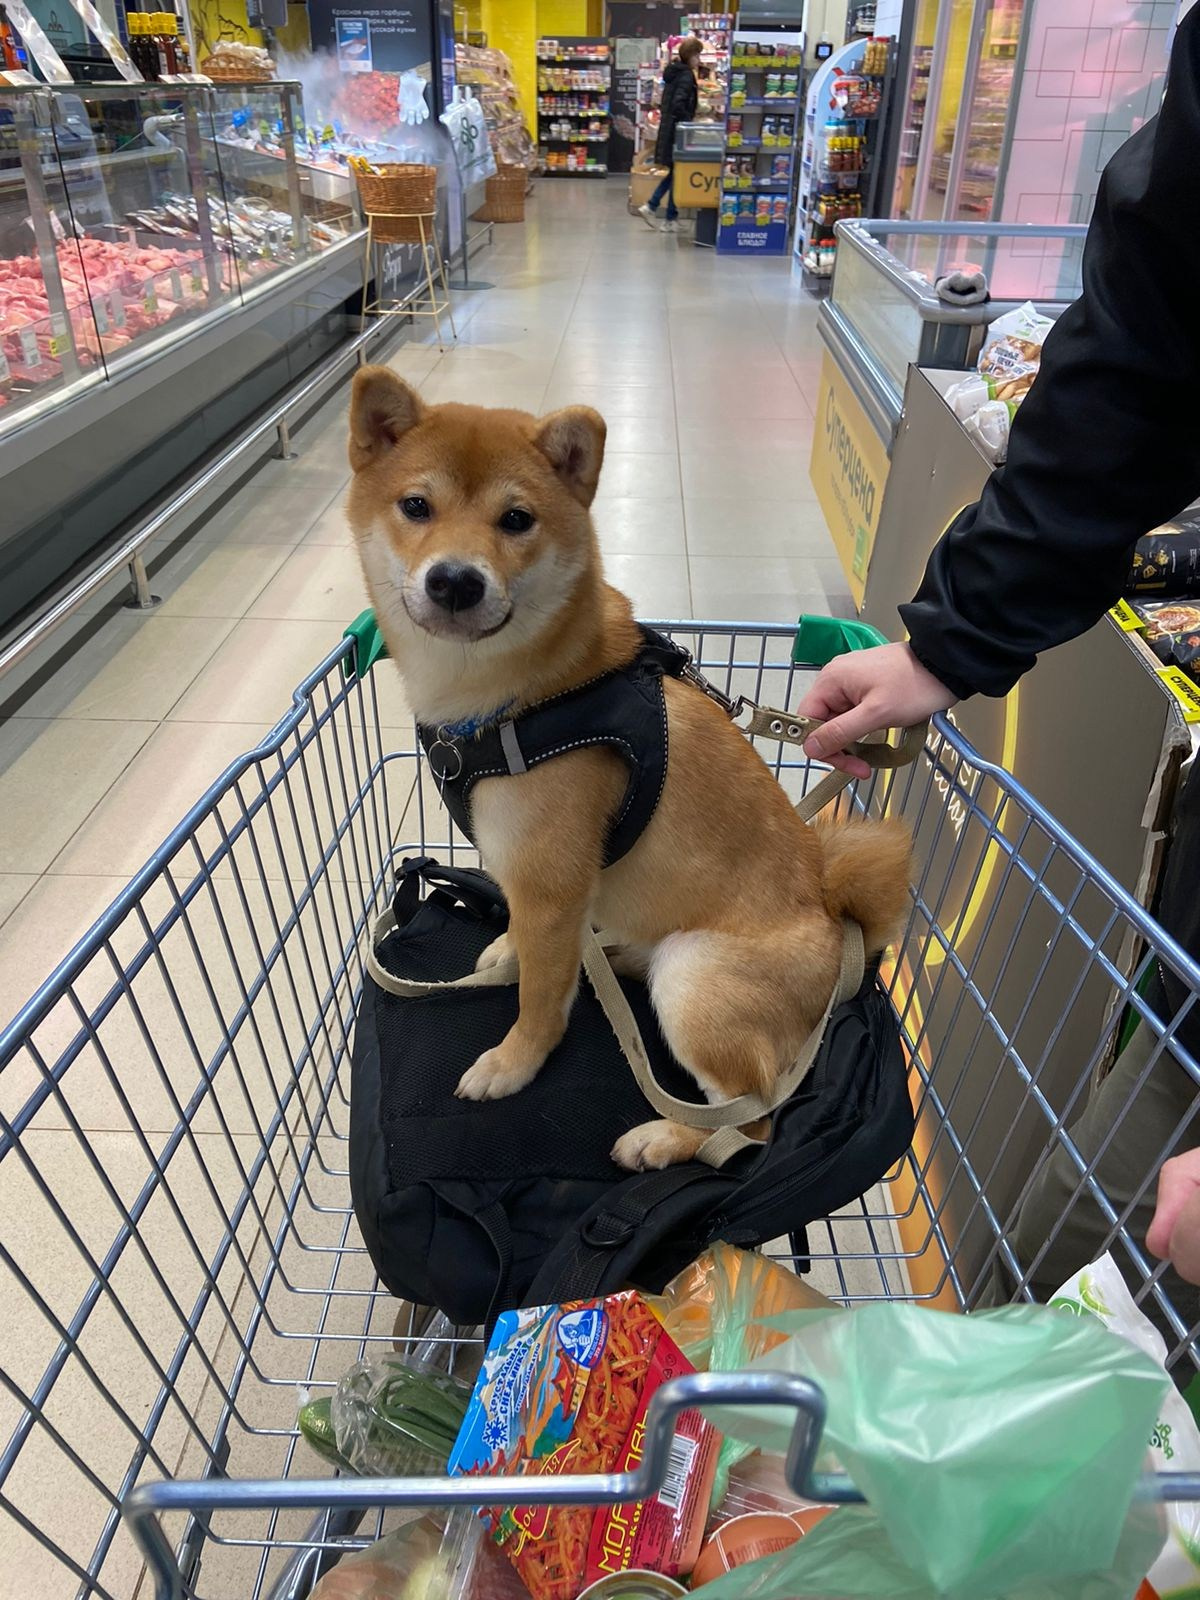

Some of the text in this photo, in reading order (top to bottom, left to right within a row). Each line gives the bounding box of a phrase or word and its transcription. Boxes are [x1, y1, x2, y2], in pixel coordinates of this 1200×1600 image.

[825, 386, 877, 527] Суперцена
[488, 1340, 523, 1414] ХРУСТАЛЬНАЯ
[499, 1347, 528, 1415] СНЕЖИНКА
